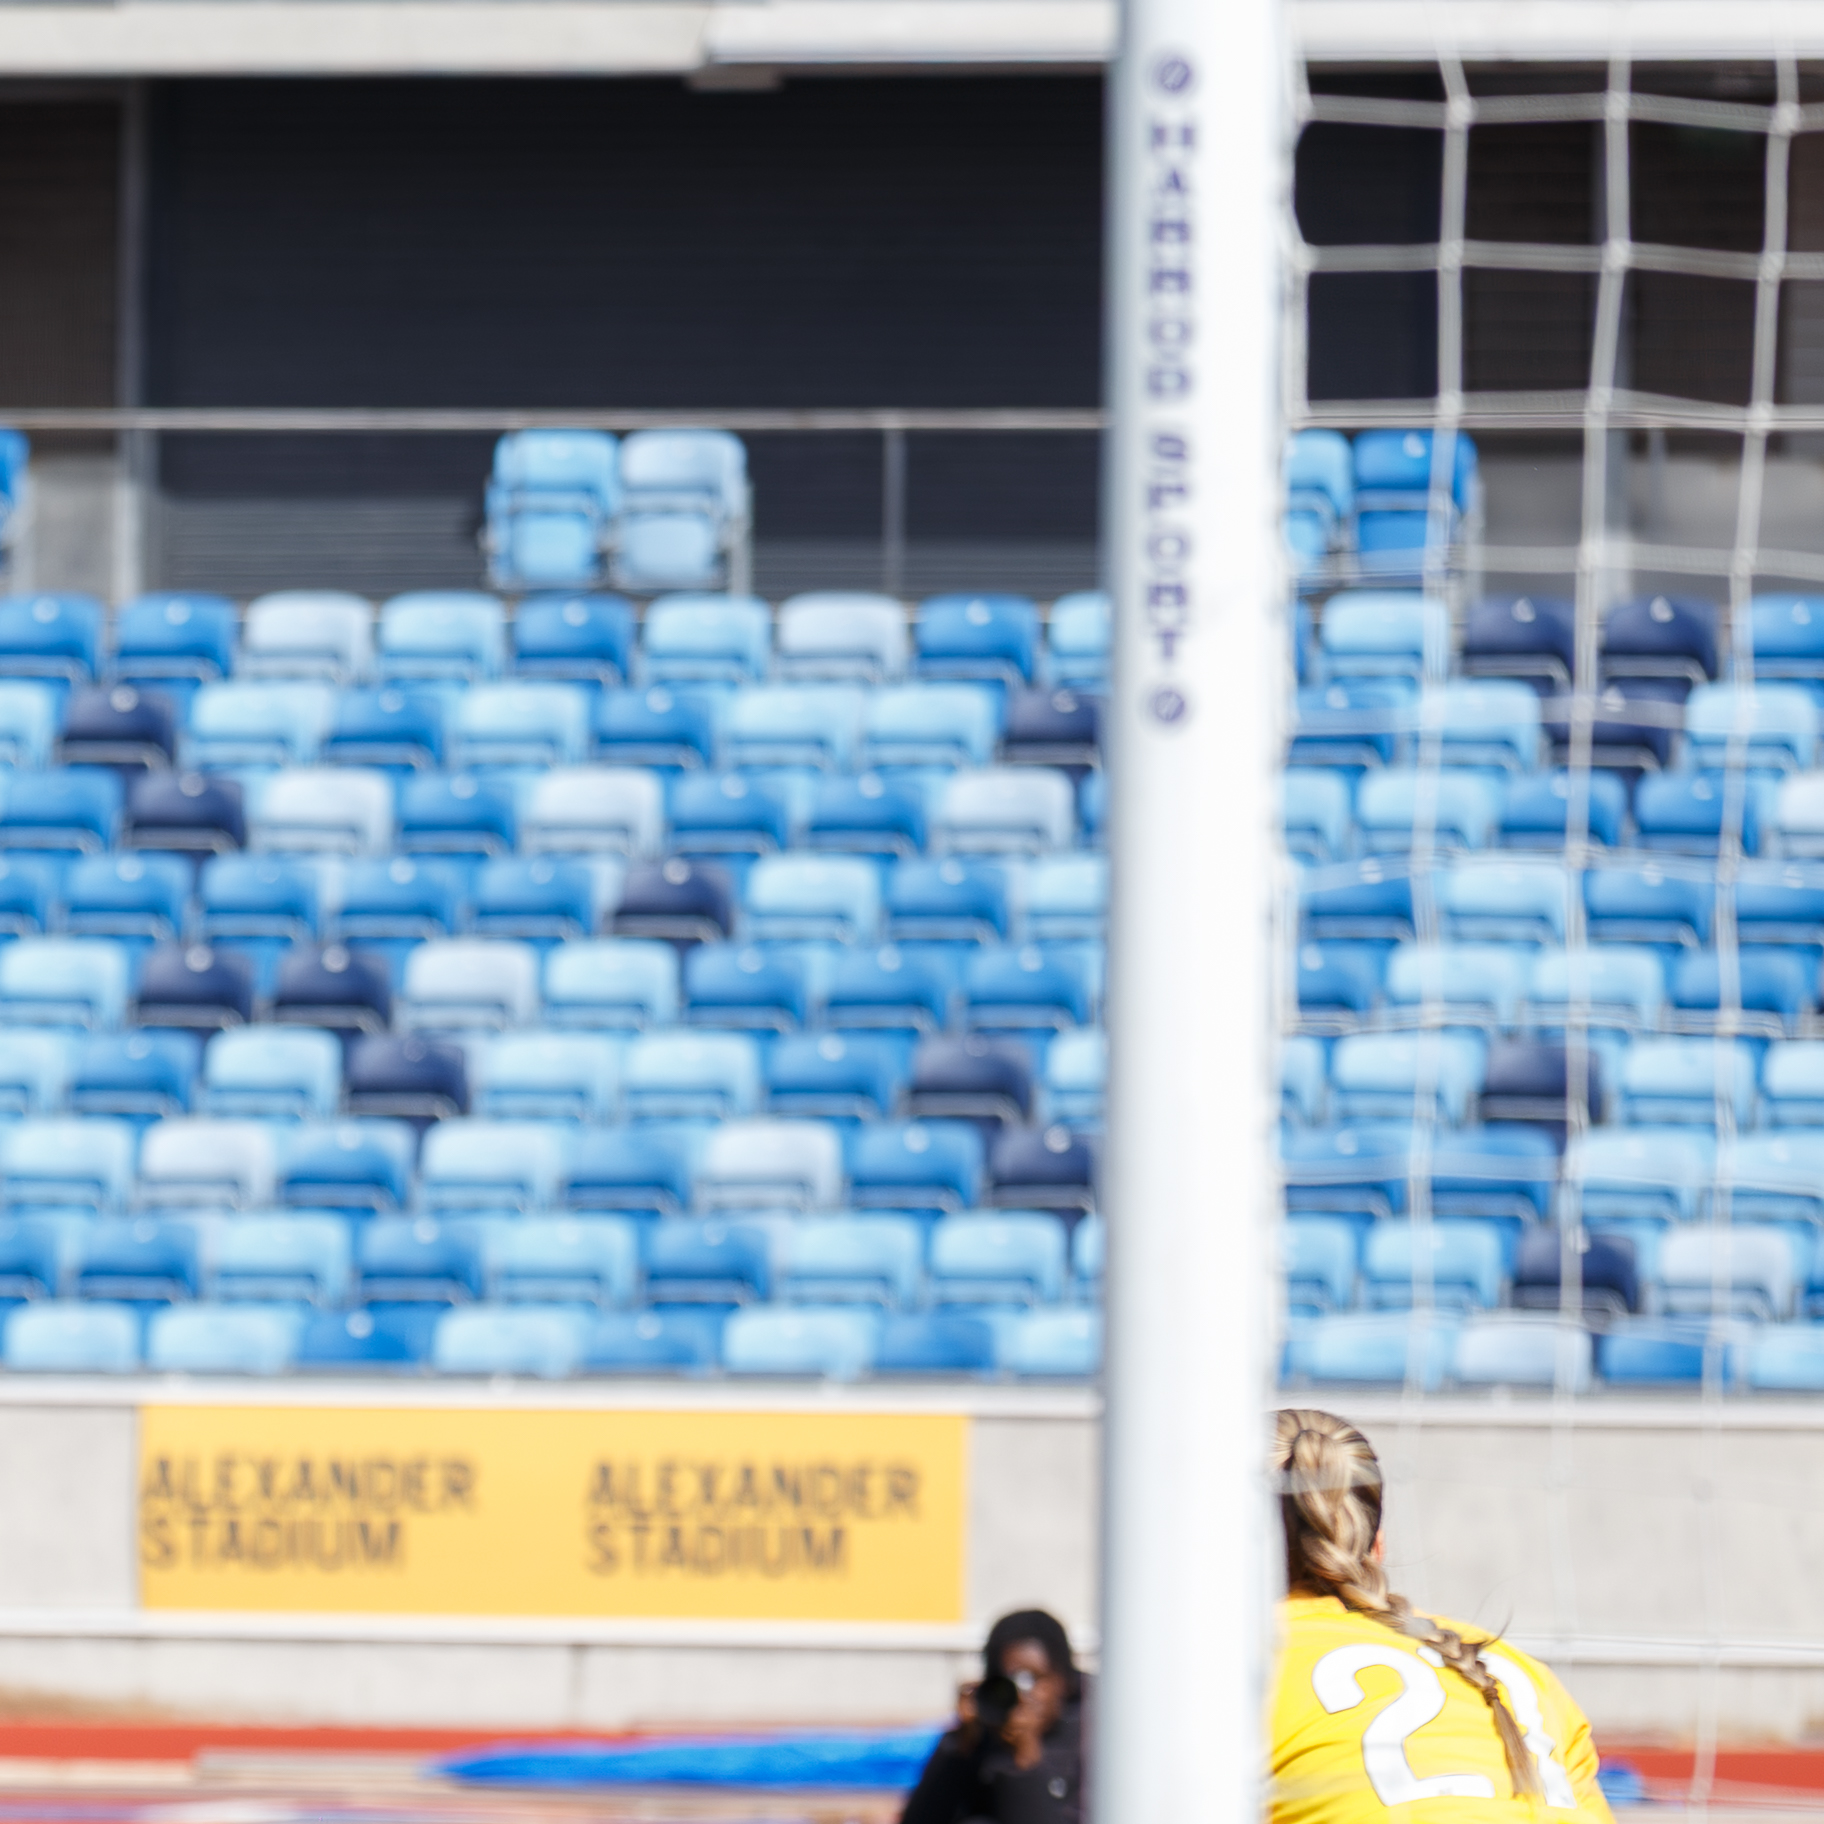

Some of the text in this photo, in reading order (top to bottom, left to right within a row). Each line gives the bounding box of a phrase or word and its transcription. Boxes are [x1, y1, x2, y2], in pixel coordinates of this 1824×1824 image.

[1148, 434, 1191, 662] SPORT
[142, 1457, 480, 1513] ALEXANDER
[588, 1462, 922, 1521] ALEXANDER
[142, 1516, 405, 1571] STADIUM
[587, 1523, 849, 1578] STADIUM
